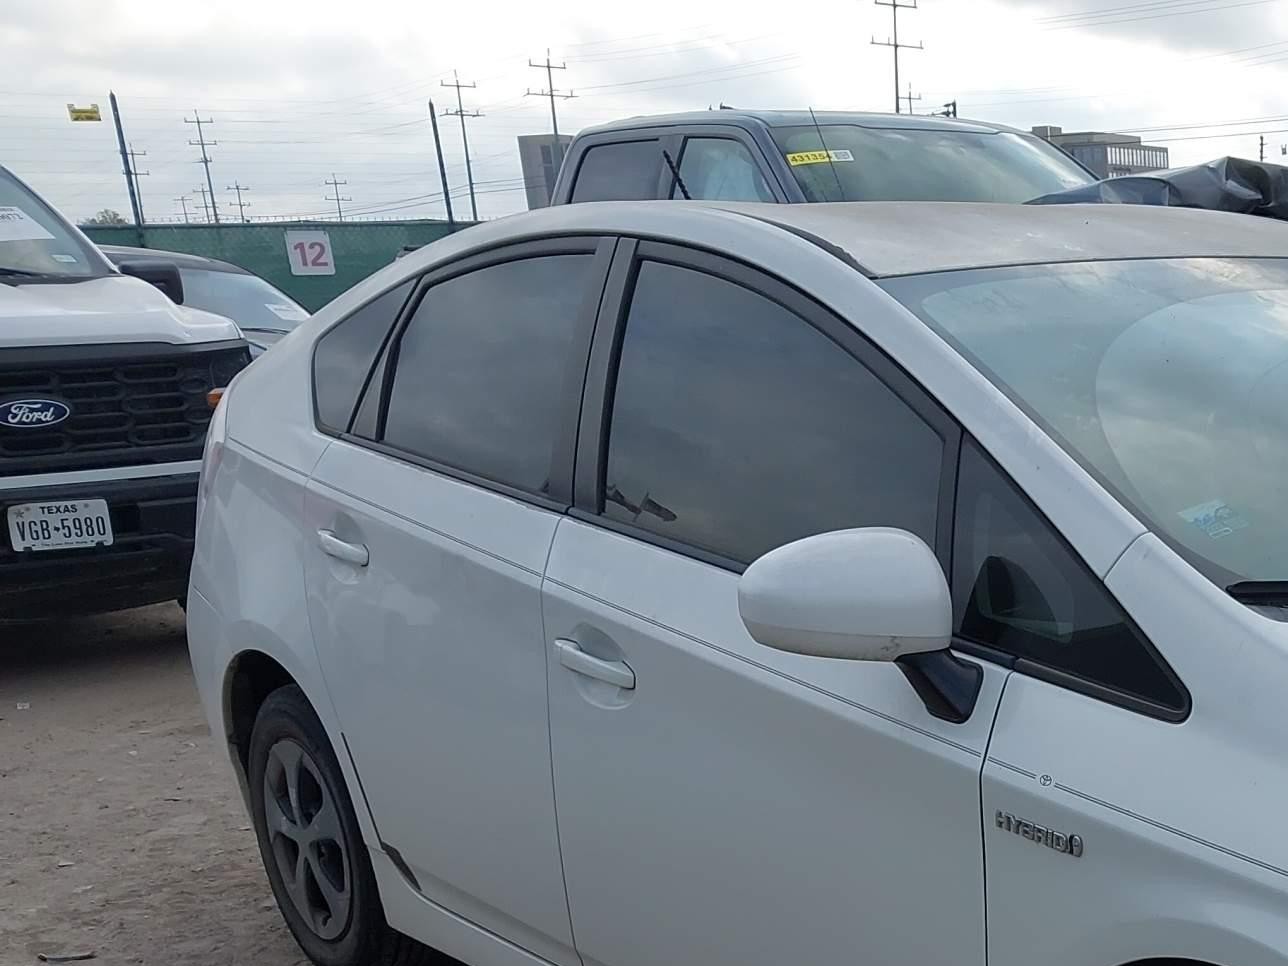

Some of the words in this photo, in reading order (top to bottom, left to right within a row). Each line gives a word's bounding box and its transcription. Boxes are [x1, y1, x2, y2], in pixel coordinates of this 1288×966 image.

[791, 153, 832, 163] 43135
[293, 242, 329, 267] 12
[7, 403, 55, 423] Ford
[39, 504, 78, 515] TEXAS
[995, 809, 1069, 853] HYBRID
